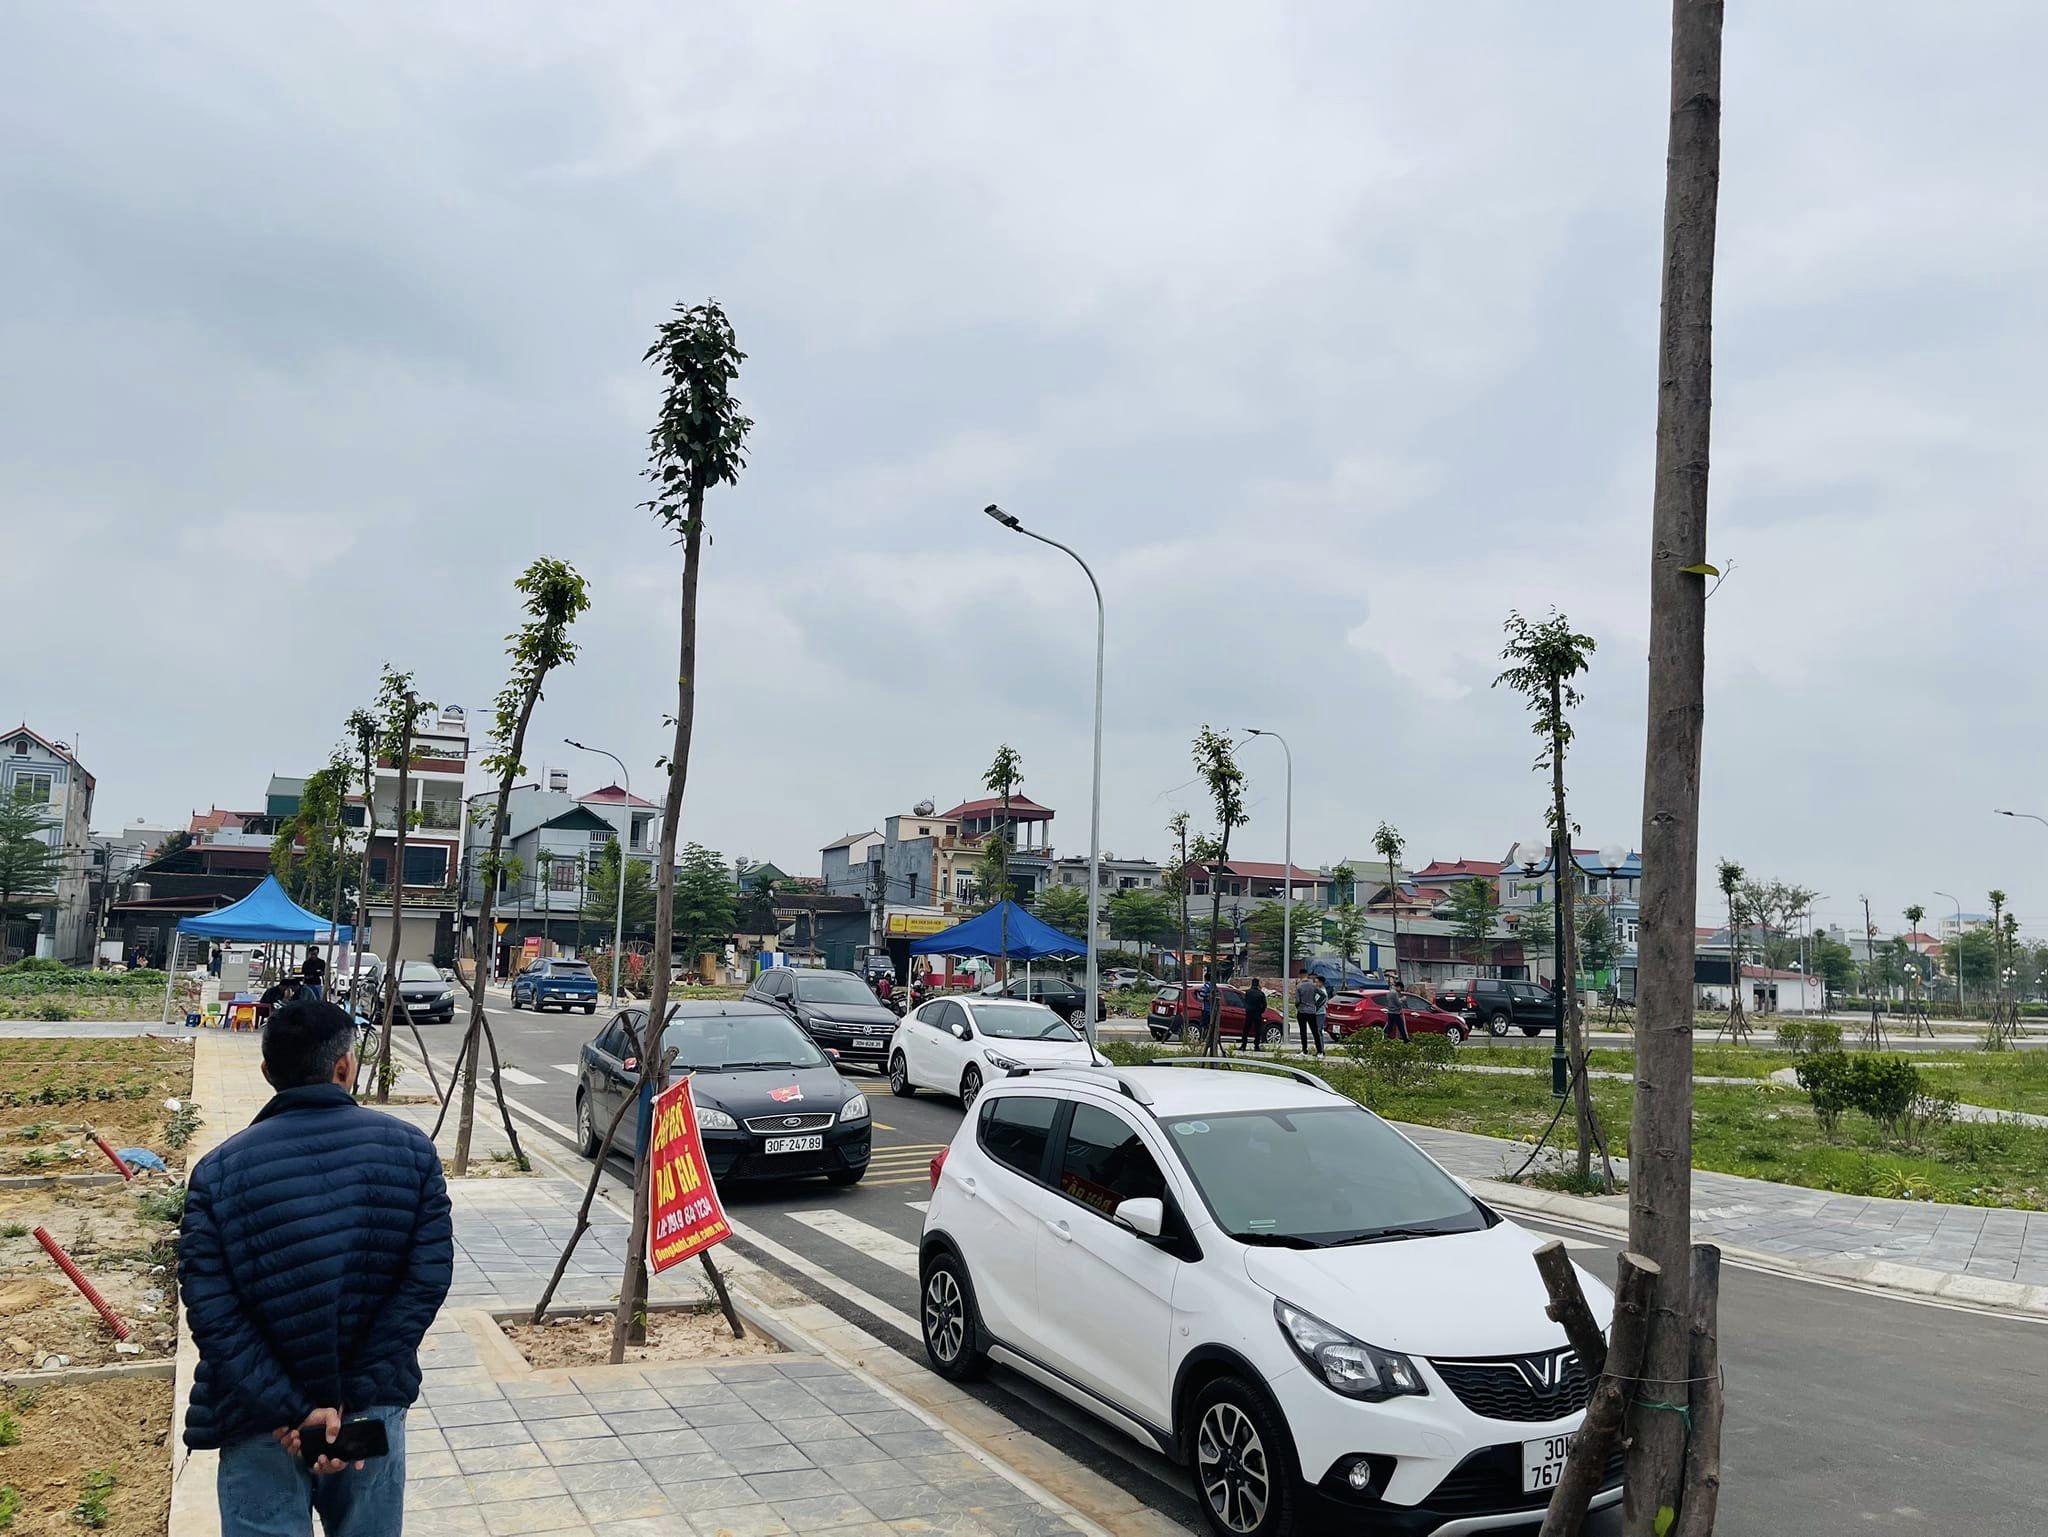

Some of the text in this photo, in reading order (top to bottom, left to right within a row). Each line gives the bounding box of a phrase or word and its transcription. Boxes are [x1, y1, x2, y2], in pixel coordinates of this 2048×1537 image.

[675, 1144, 702, 1195] GIÁ
[684, 1204, 697, 1226] 84
[694, 1196, 713, 1220] 1234
